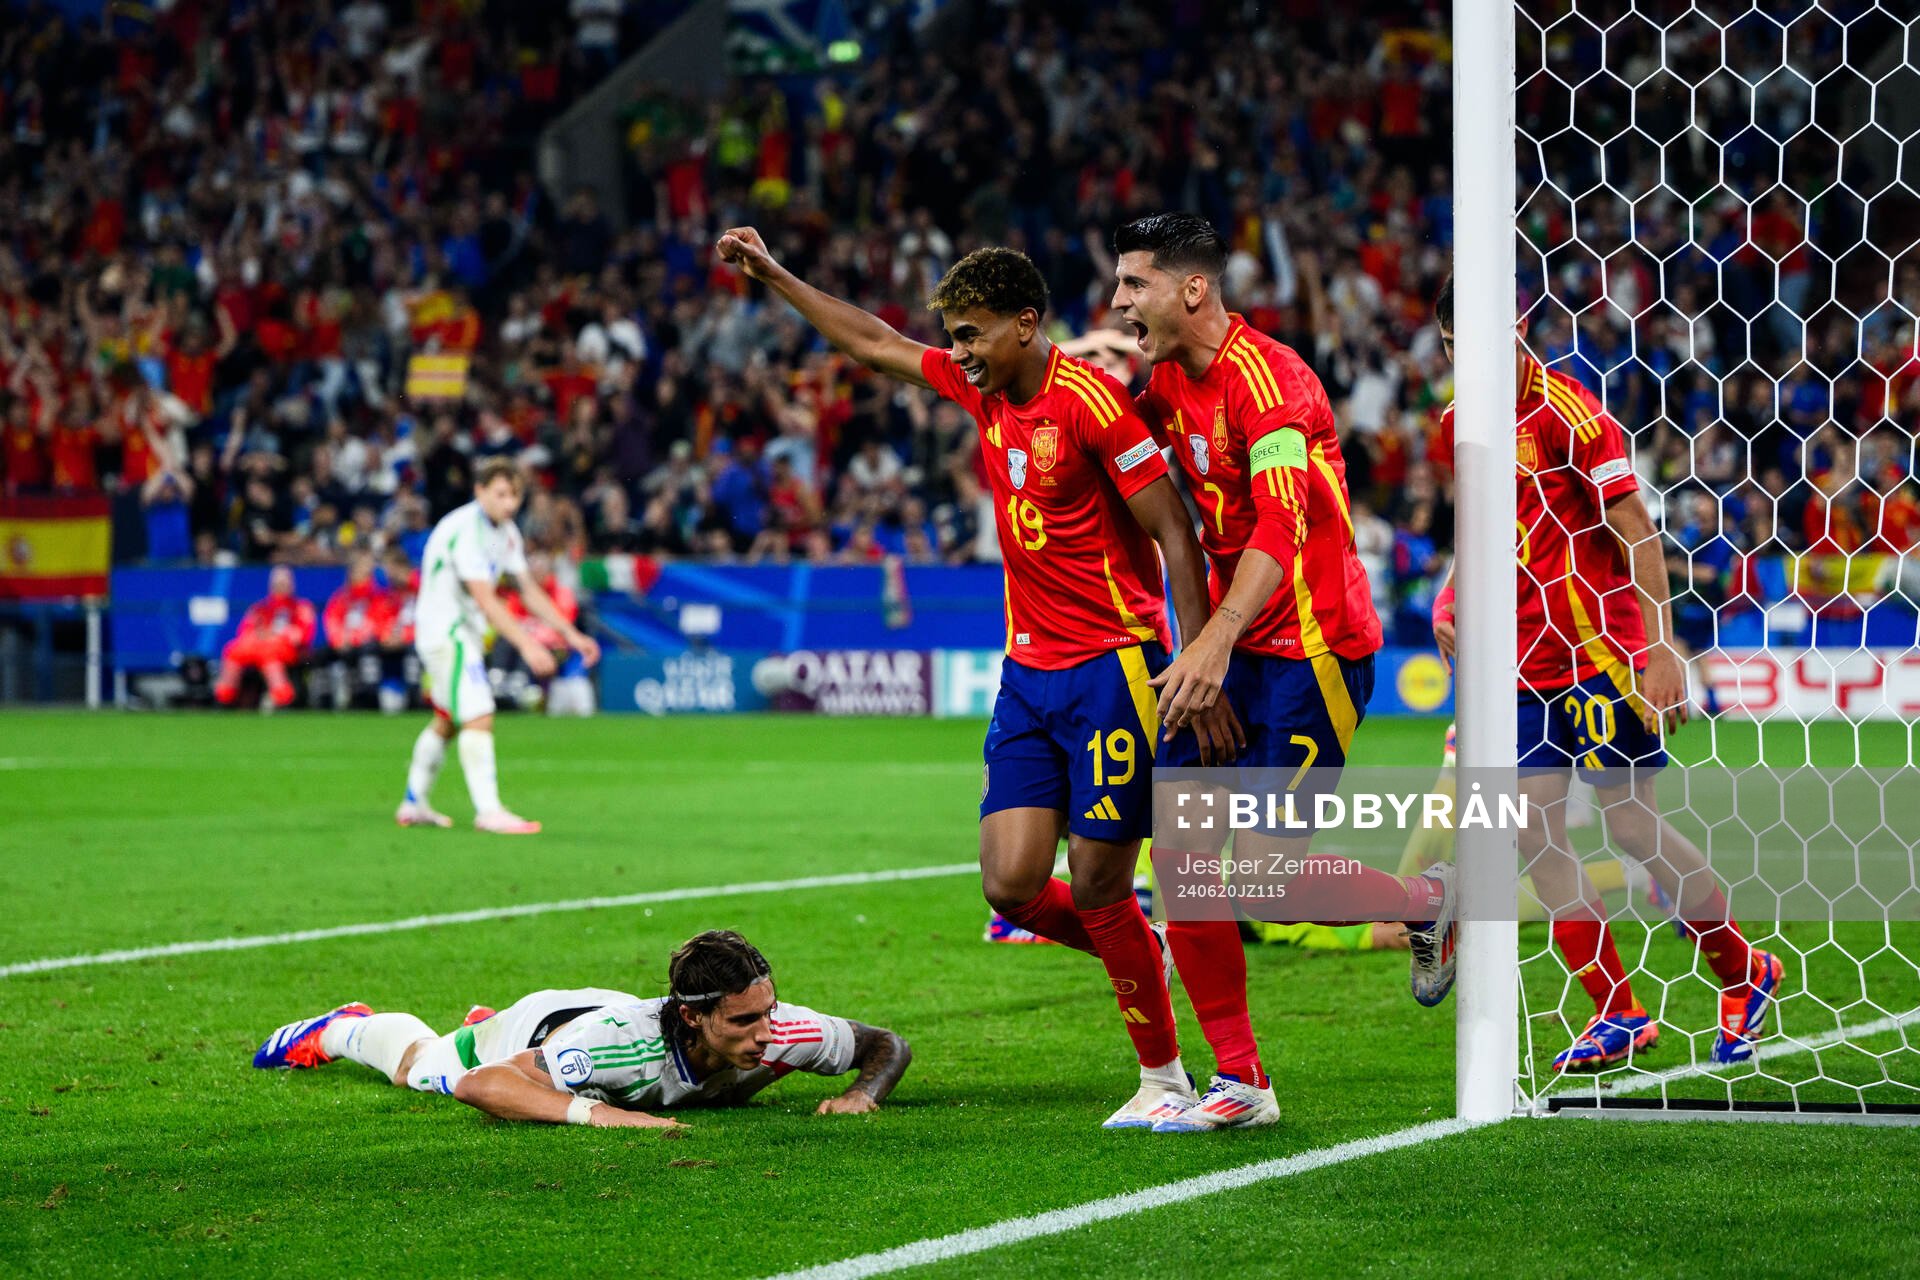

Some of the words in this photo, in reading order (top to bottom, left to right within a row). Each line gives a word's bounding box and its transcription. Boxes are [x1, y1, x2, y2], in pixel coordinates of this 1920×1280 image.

[1007, 495, 1047, 551] 19
[1204, 483, 1224, 535] 7
[785, 650, 923, 697] QATAR
[1703, 655, 1920, 712] BY
[1087, 728, 1135, 786] 19
[1287, 734, 1318, 791] 7
